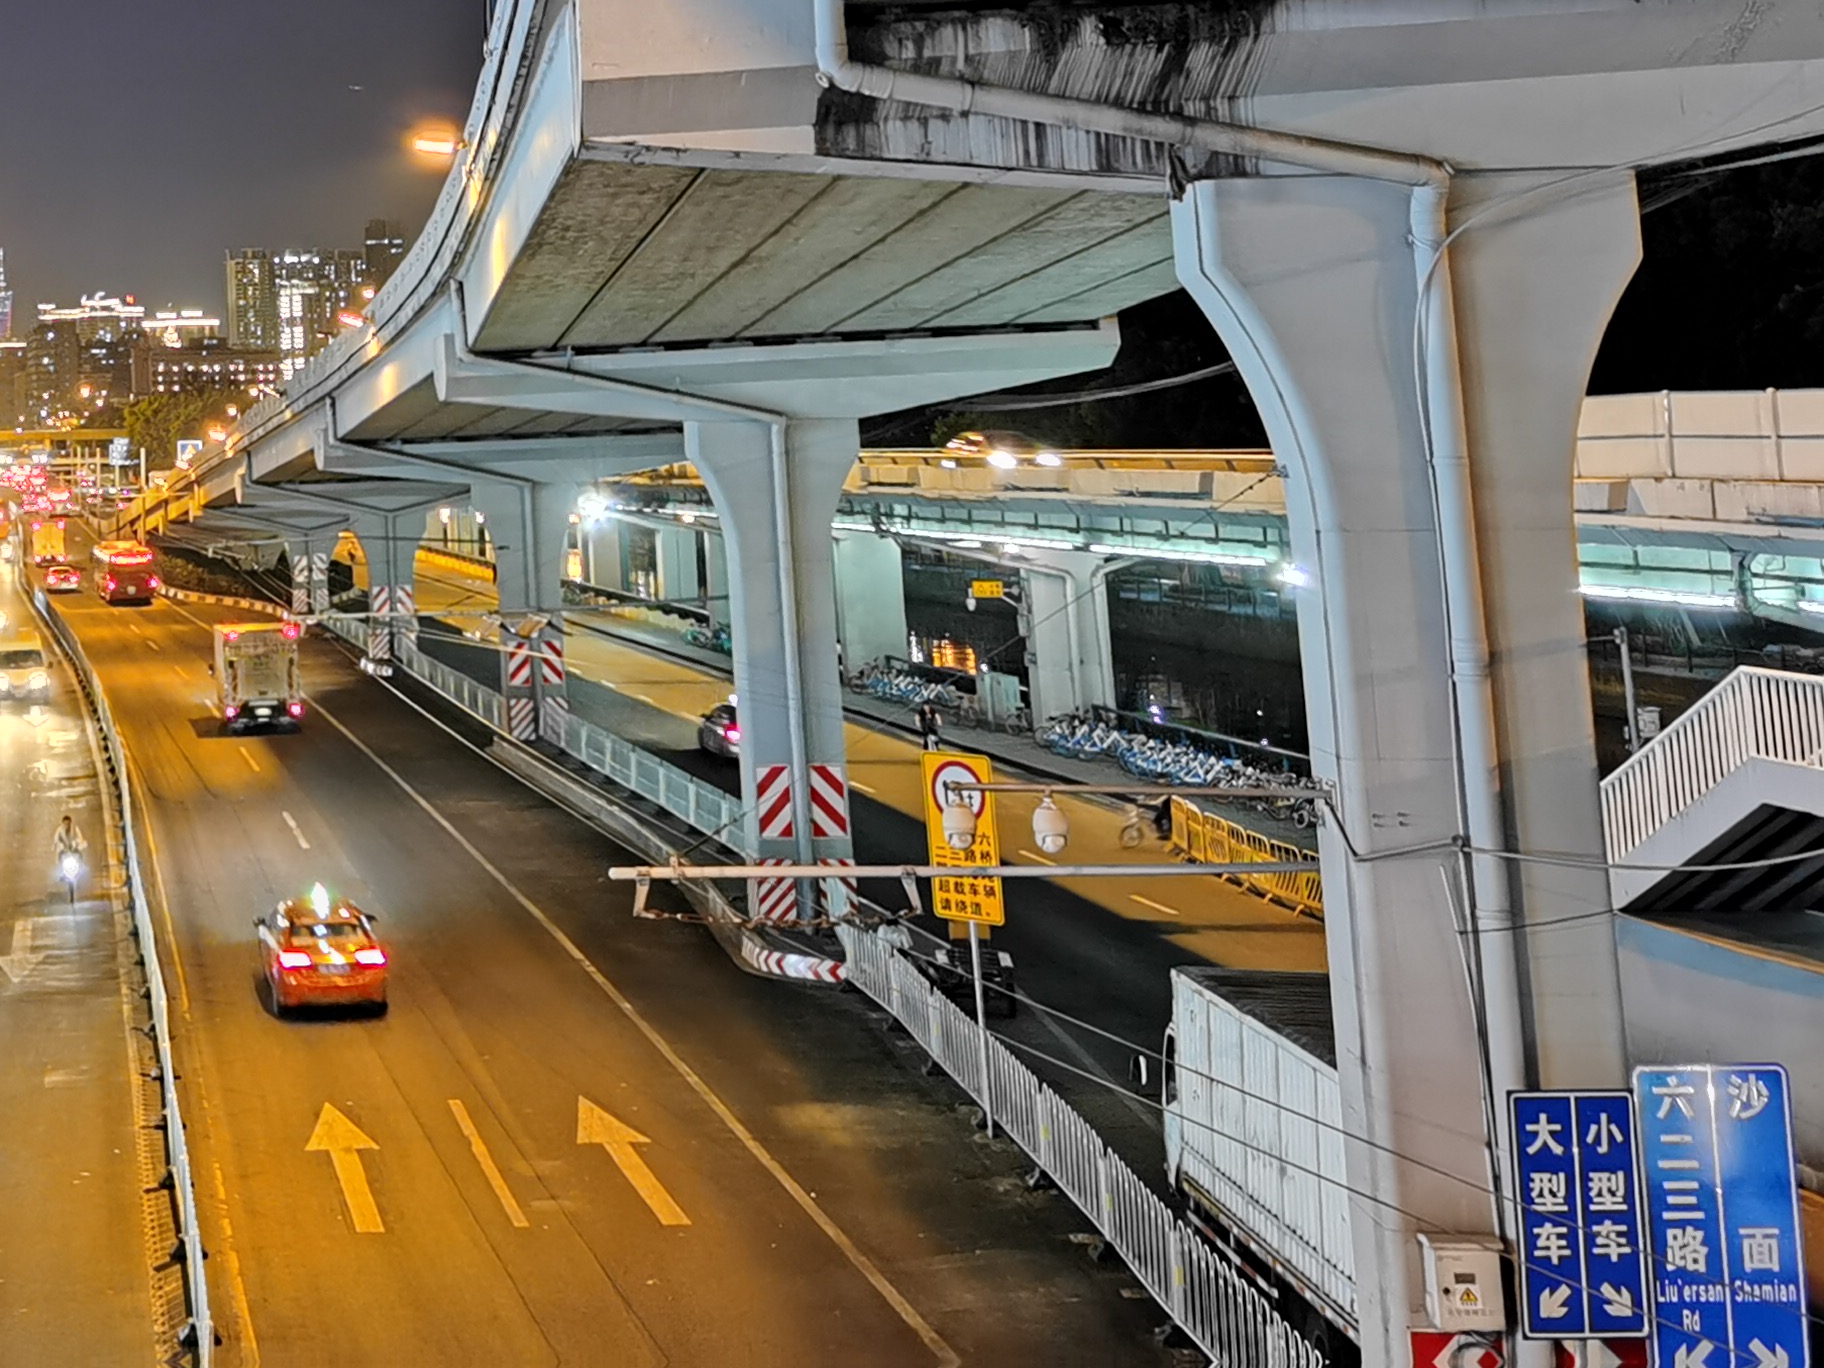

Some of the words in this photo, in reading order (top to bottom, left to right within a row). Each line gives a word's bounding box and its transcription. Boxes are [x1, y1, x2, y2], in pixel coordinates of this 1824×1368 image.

[1525, 1113, 1571, 1265] 大型车
[1585, 1112, 1631, 1263] 小型车
[1651, 1075, 1708, 1273] 六二三路
[1726, 1073, 1781, 1273] 沙面
[1682, 1308, 1701, 1332] Rd
[1734, 1279, 1797, 1303] Shamian
